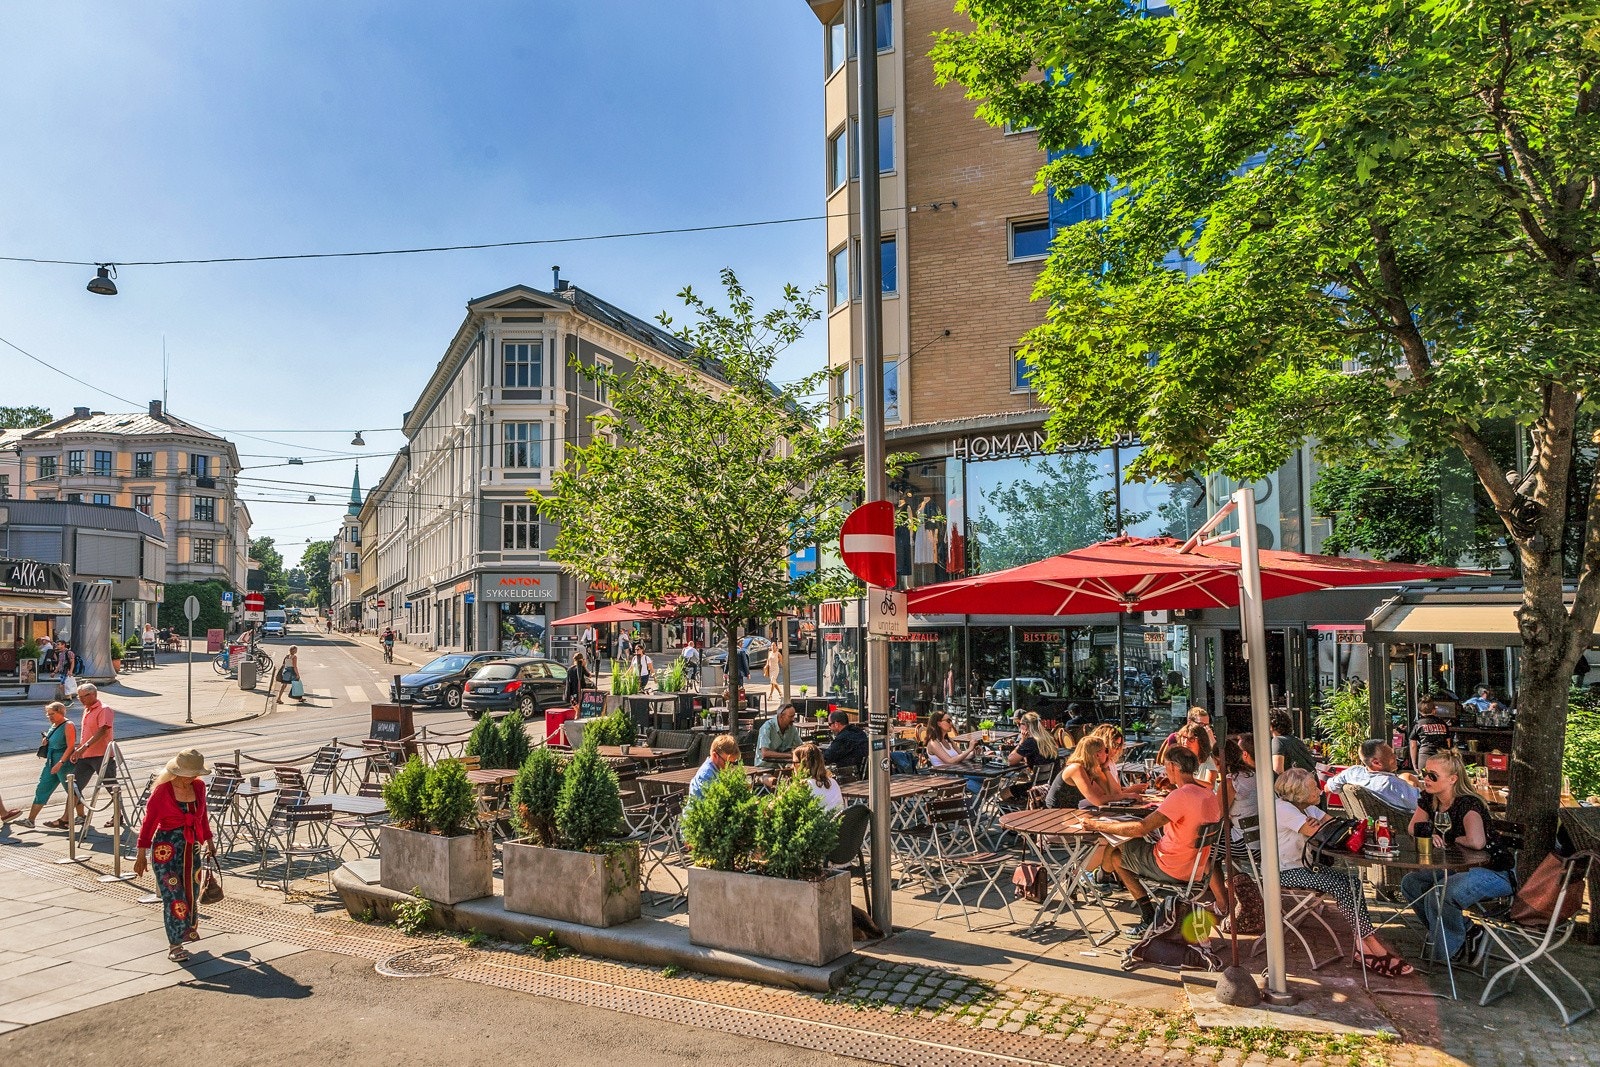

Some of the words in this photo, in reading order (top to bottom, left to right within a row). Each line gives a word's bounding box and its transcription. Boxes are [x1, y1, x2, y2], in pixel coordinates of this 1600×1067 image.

[953, 431, 1050, 459] HOMAN
[11, 562, 45, 586] AKKA
[498, 577, 541, 586] ANTON
[486, 589, 553, 598] SYKKELDELISK
[878, 621, 899, 631] unntatt
[1023, 632, 1060, 642] BISTRO
[1144, 632, 1166, 643] BAR
[1337, 633, 1364, 643] FOO
